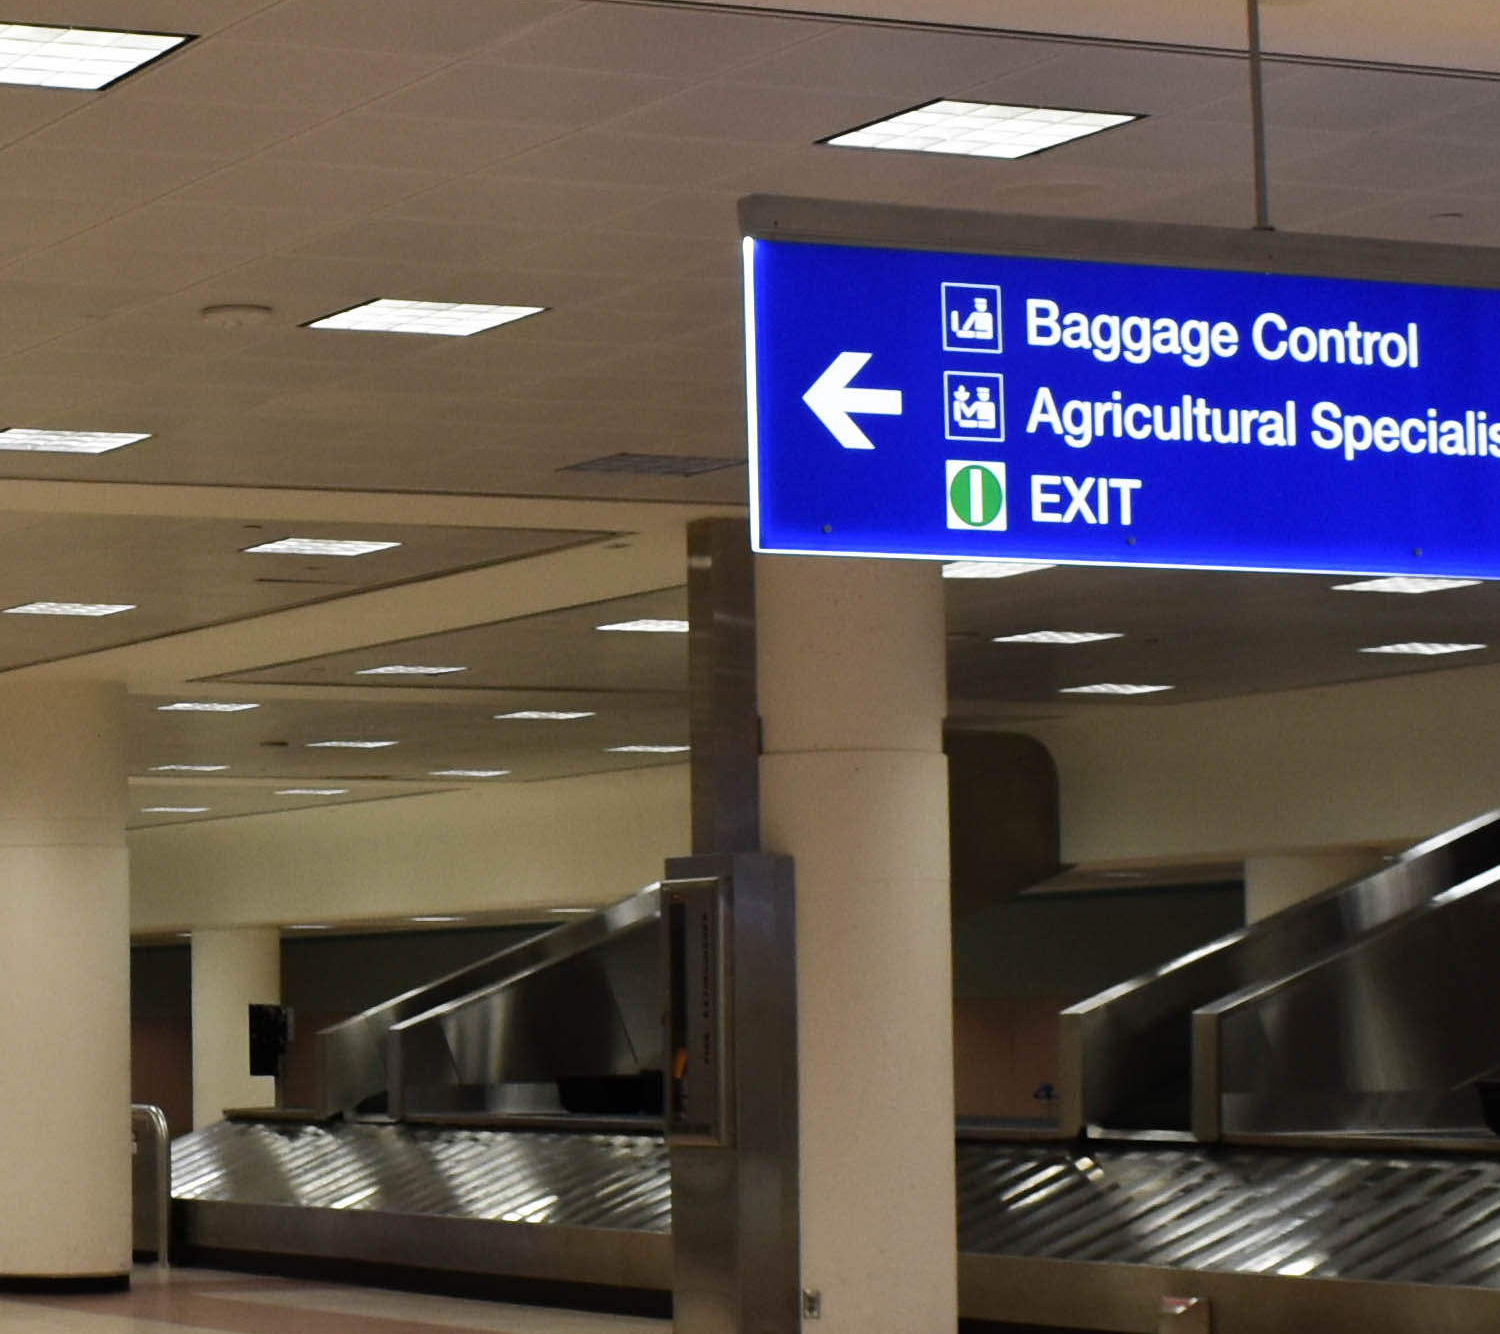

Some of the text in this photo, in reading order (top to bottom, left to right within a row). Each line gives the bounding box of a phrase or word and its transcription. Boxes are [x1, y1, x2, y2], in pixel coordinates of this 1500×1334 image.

[1027, 299, 1418, 367] Baggage Control
[1027, 387, 1296, 448] Agricultural
[1031, 475, 1141, 525] EXIT
